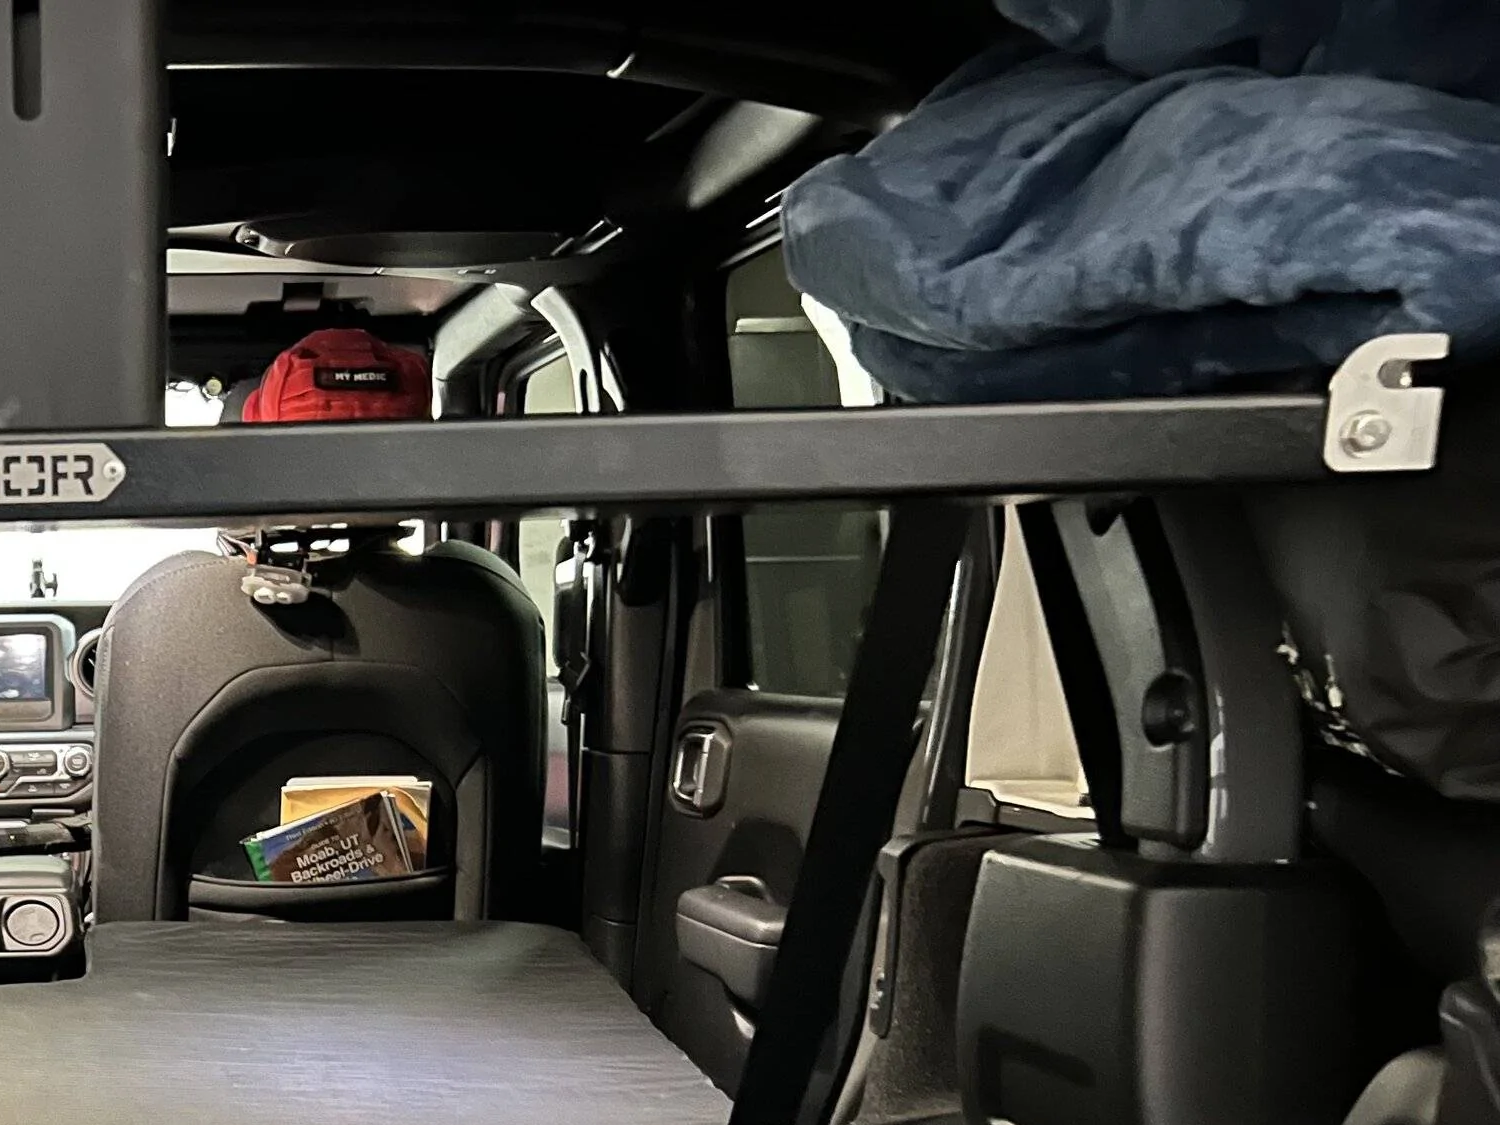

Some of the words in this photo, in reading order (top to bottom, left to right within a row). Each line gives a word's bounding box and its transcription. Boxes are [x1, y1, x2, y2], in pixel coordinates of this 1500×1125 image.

[335, 372, 351, 381] MY
[353, 372, 387, 381] MEDIC
[290, 849, 363, 883] Backroads
[296, 846, 339, 868] Moab,
[340, 833, 359, 850] UT
